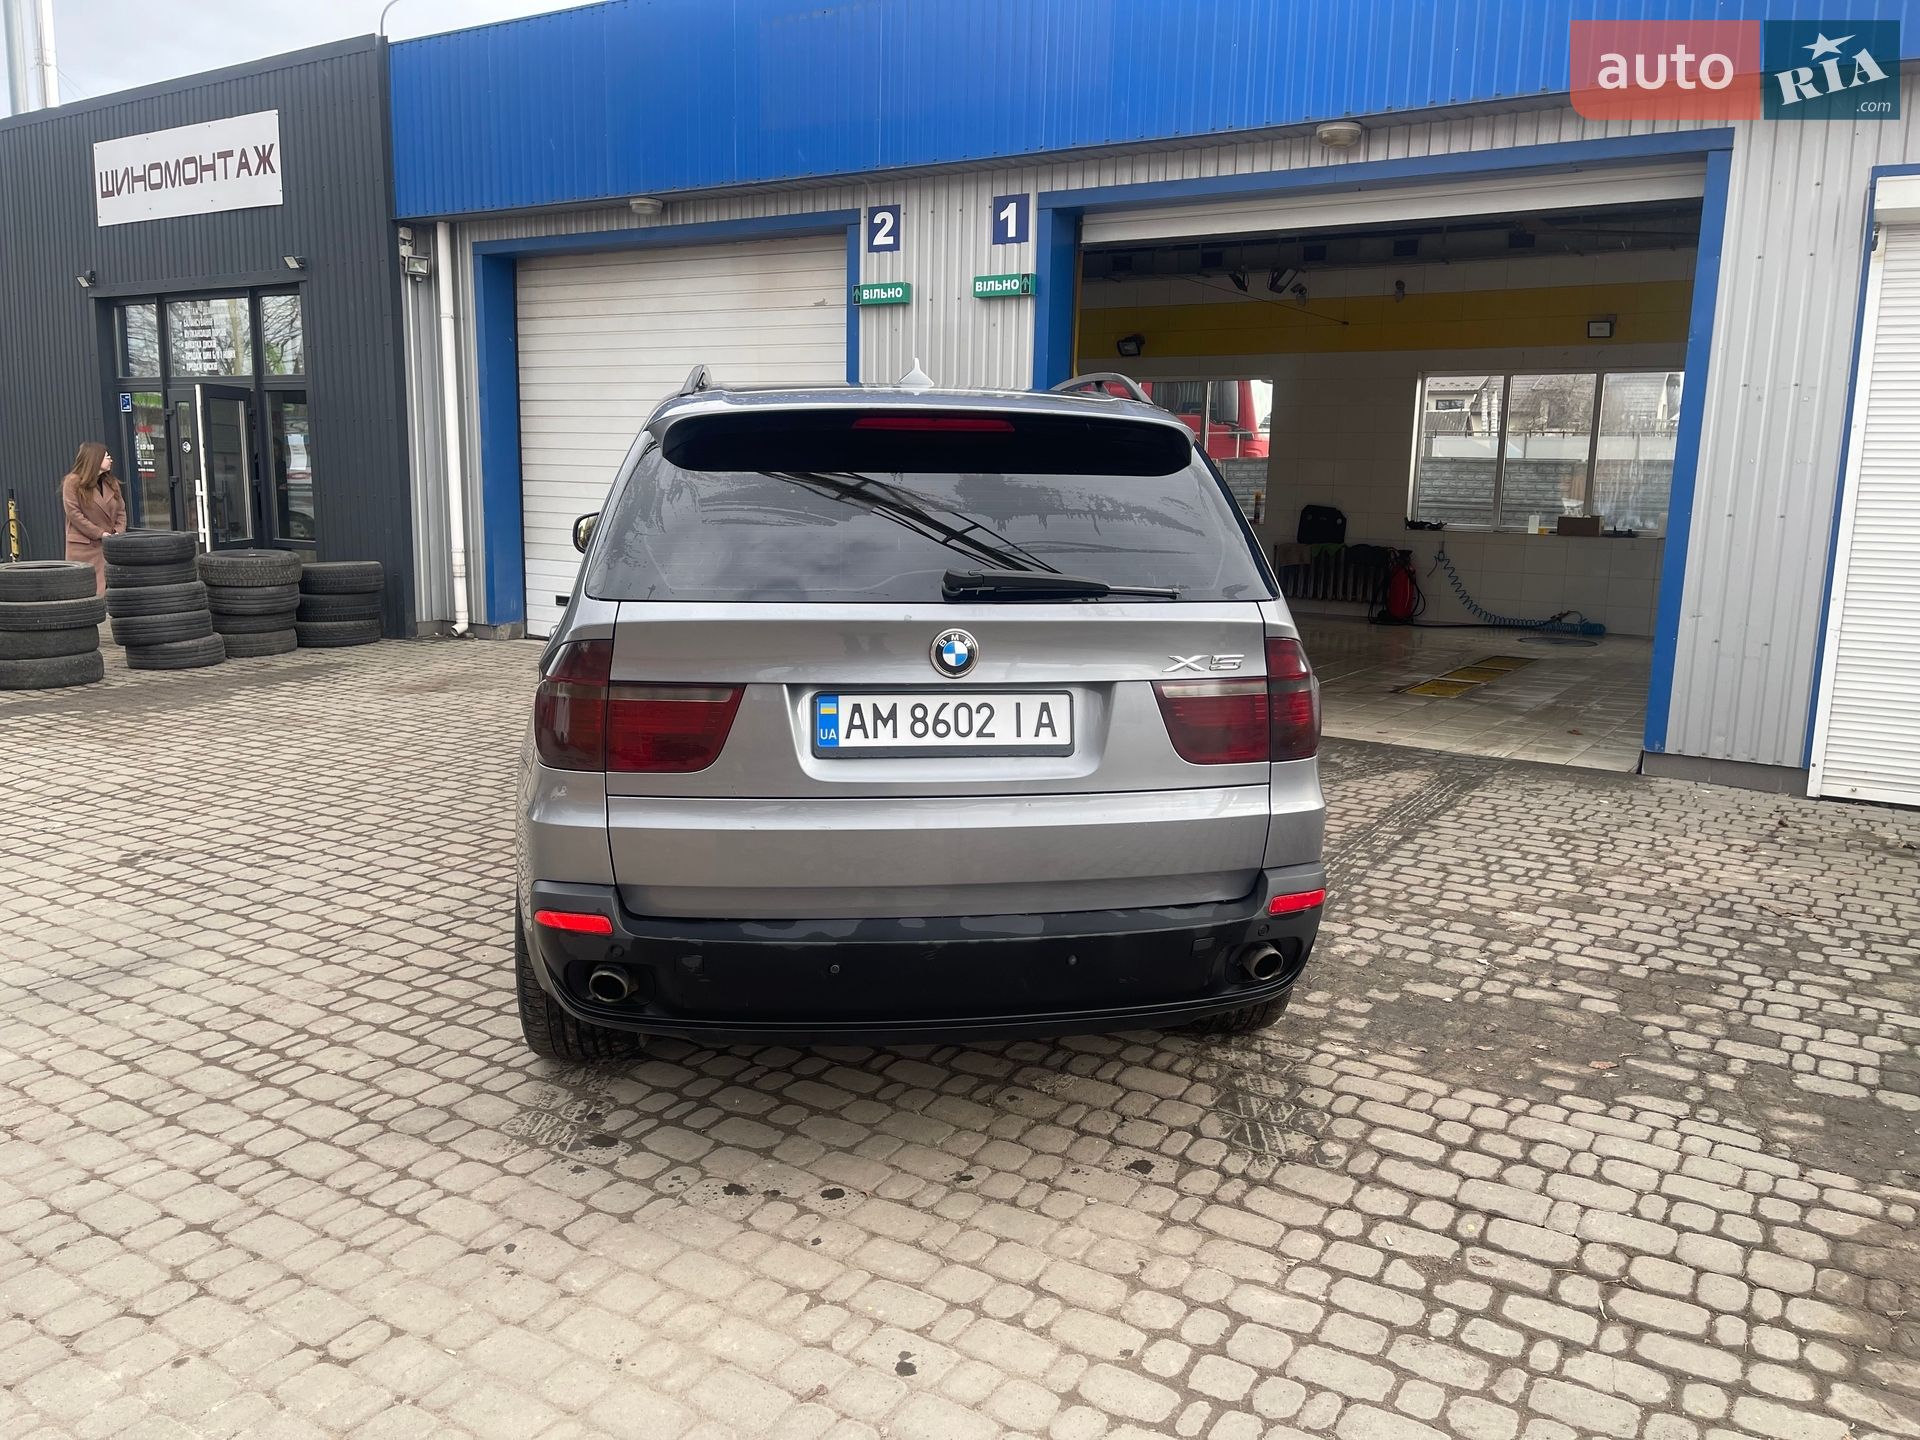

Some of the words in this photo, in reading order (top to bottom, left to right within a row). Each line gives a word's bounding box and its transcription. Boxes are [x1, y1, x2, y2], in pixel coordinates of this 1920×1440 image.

[99, 143, 276, 198] ШИНОМОНТАЖ
[872, 211, 894, 246] 2
[1000, 202, 1017, 238] 1
[862, 287, 903, 300] ВІЛЬНО
[975, 278, 1020, 293] ВІЛЬНО
[939, 634, 972, 648] BMW
[1162, 654, 1245, 672] X5
[845, 702, 898, 739] AM
[910, 702, 995, 738] 8602
[1015, 702, 1057, 738] IA
[820, 728, 837, 740] UA
